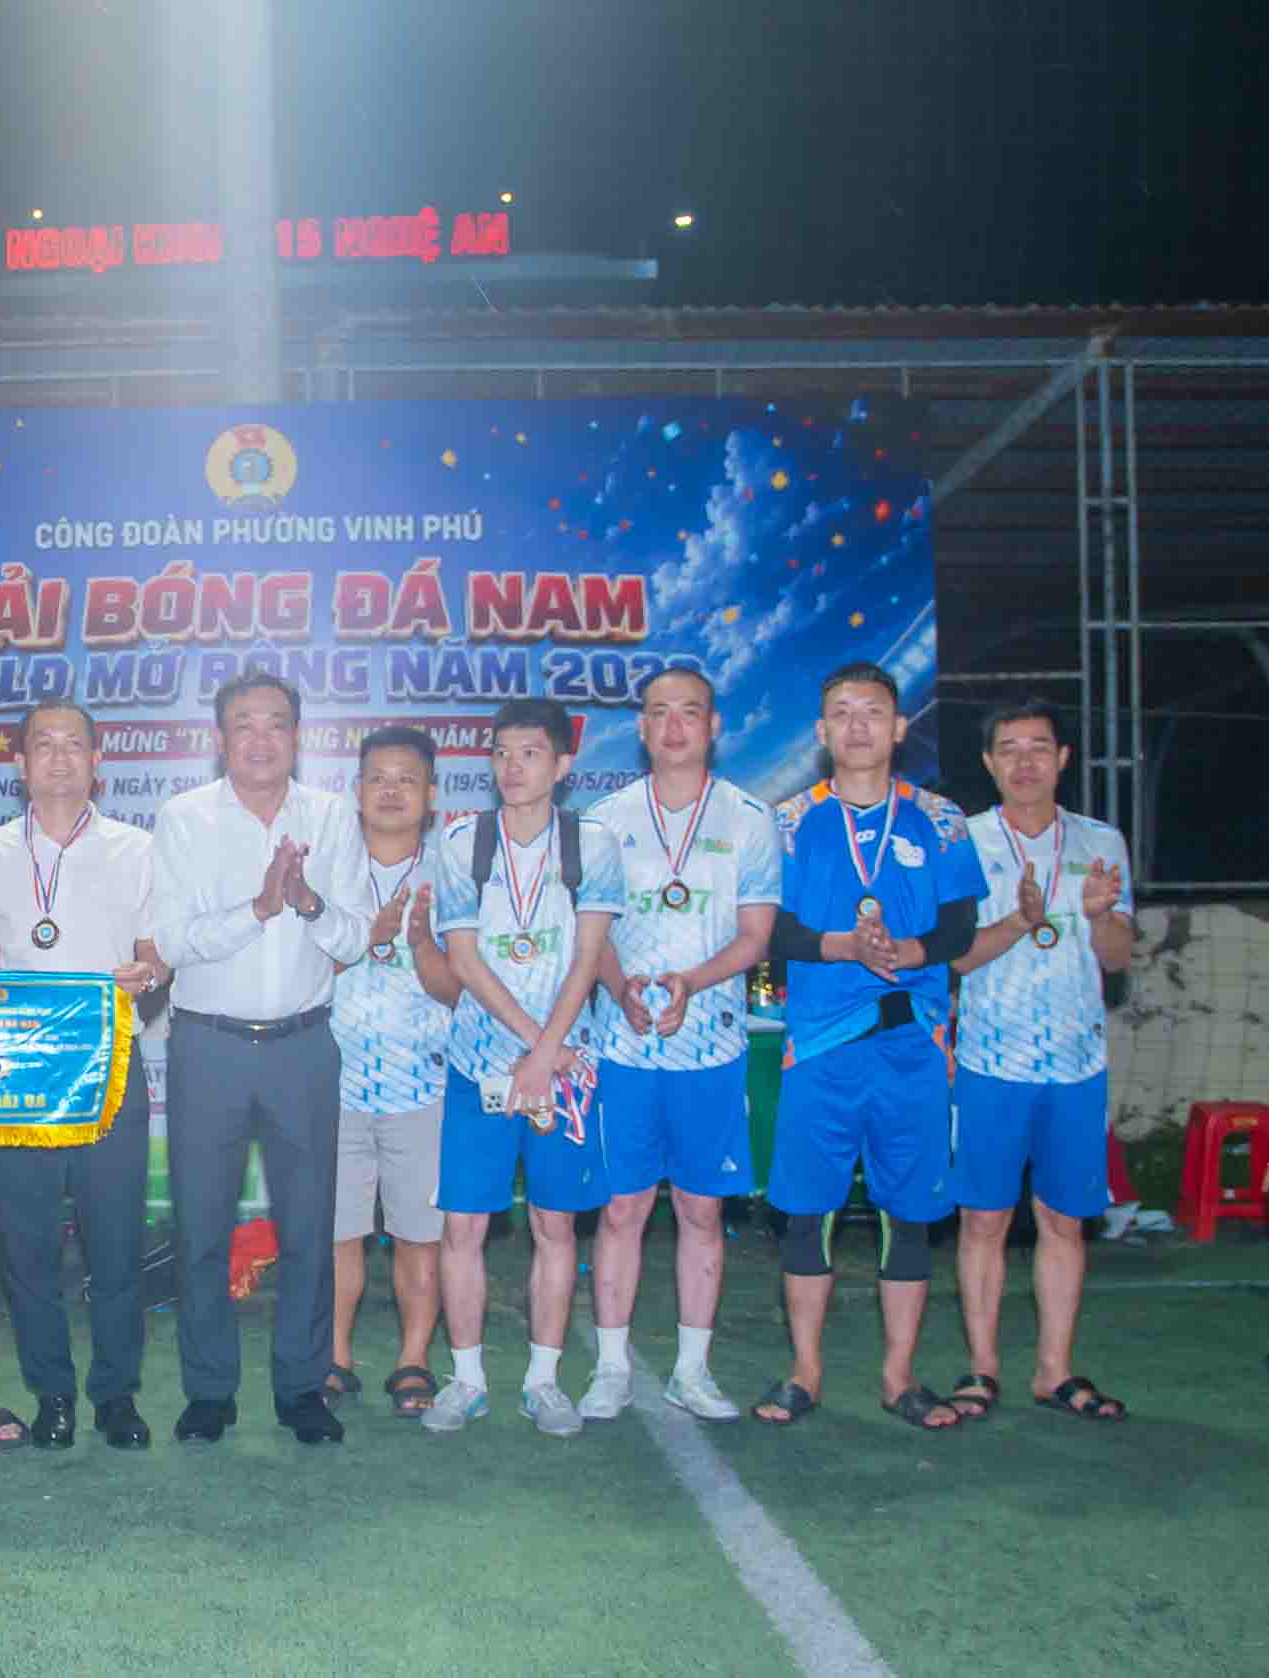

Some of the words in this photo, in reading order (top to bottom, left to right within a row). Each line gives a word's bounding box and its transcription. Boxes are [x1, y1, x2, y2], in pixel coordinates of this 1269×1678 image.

[34, 516, 115, 549] CÔNG
[122, 513, 204, 547] ĐOÀN
[342, 513, 414, 543] VINH
[422, 508, 483, 542] PHÚ
[81, 559, 312, 646] BÓNG
[332, 556, 453, 640] ĐÁ
[468, 570, 647, 641] NAM
[386, 638, 530, 702] NĂM
